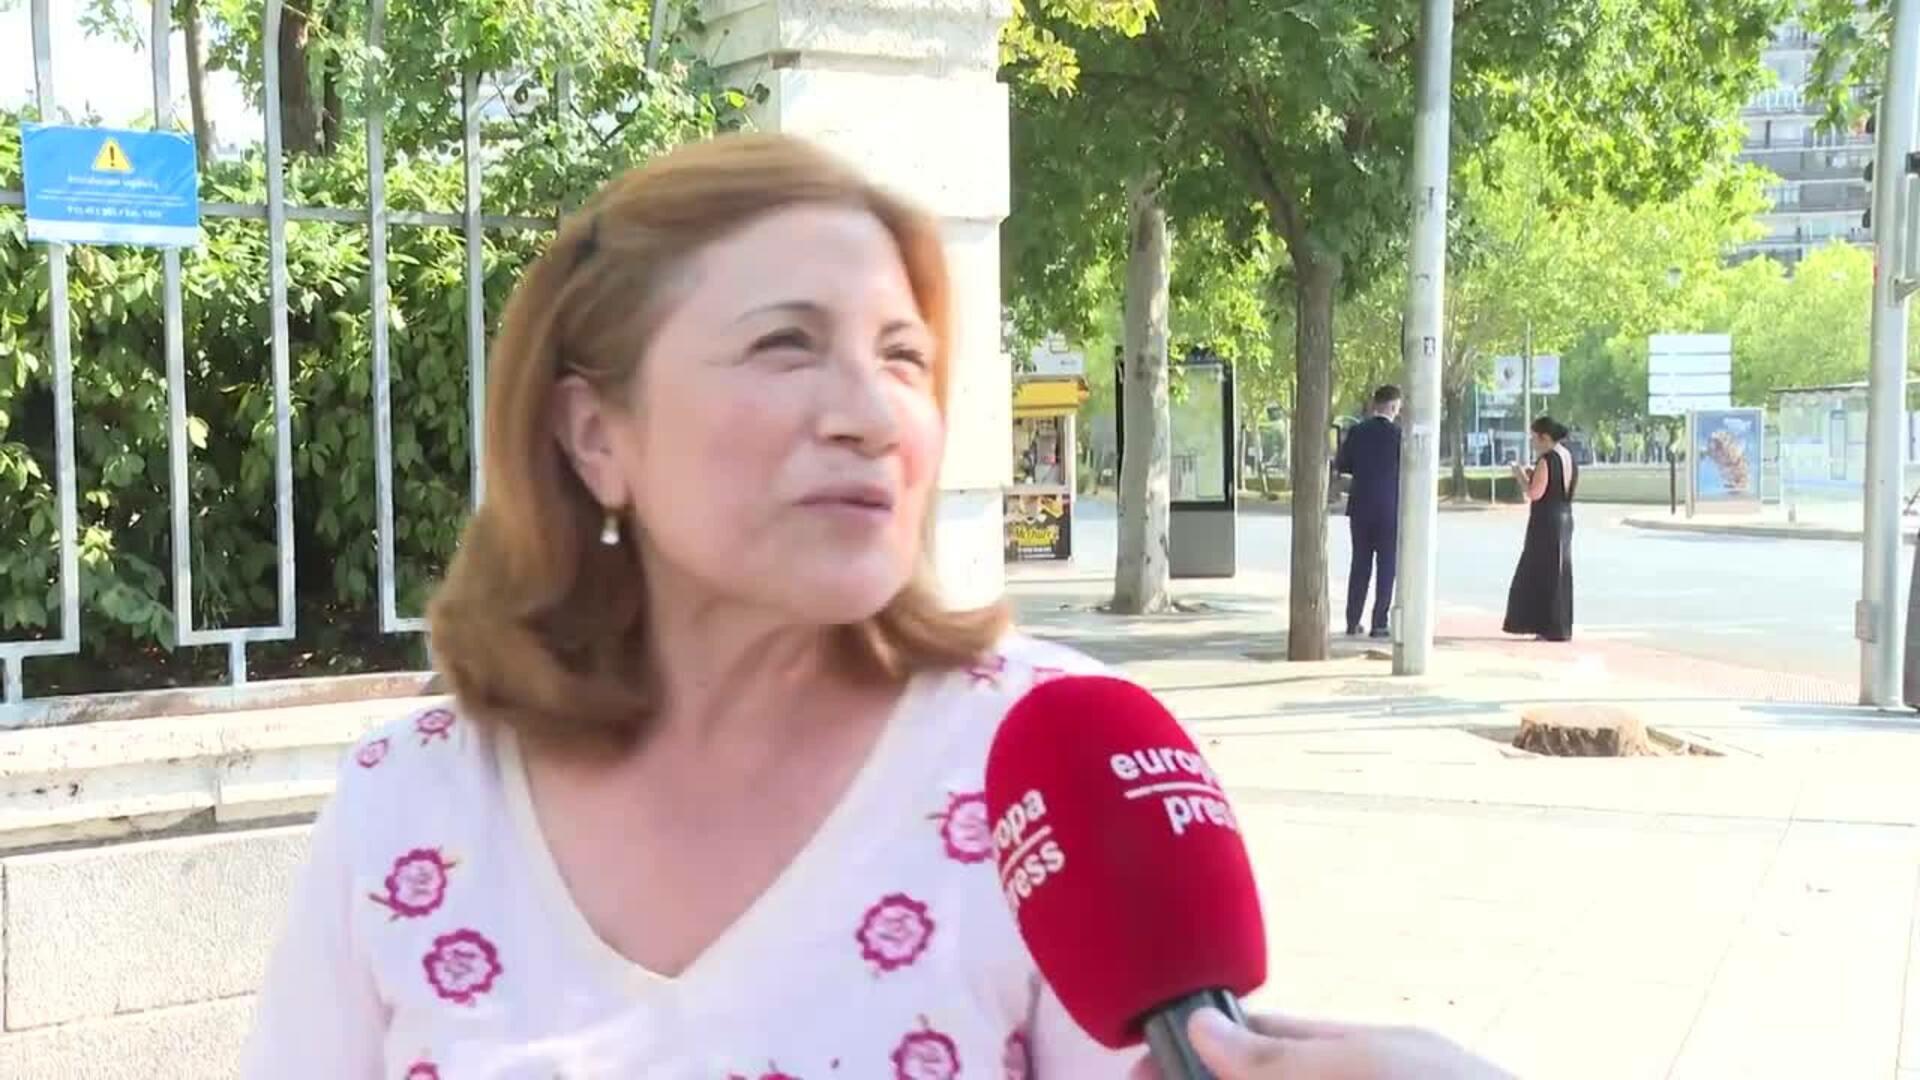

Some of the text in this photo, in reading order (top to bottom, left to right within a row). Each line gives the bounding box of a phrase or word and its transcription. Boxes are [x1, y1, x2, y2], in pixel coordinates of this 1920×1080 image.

[1110, 747, 1219, 788] europ
[1163, 795, 1238, 835] pre
[1007, 841, 1065, 912] ress
